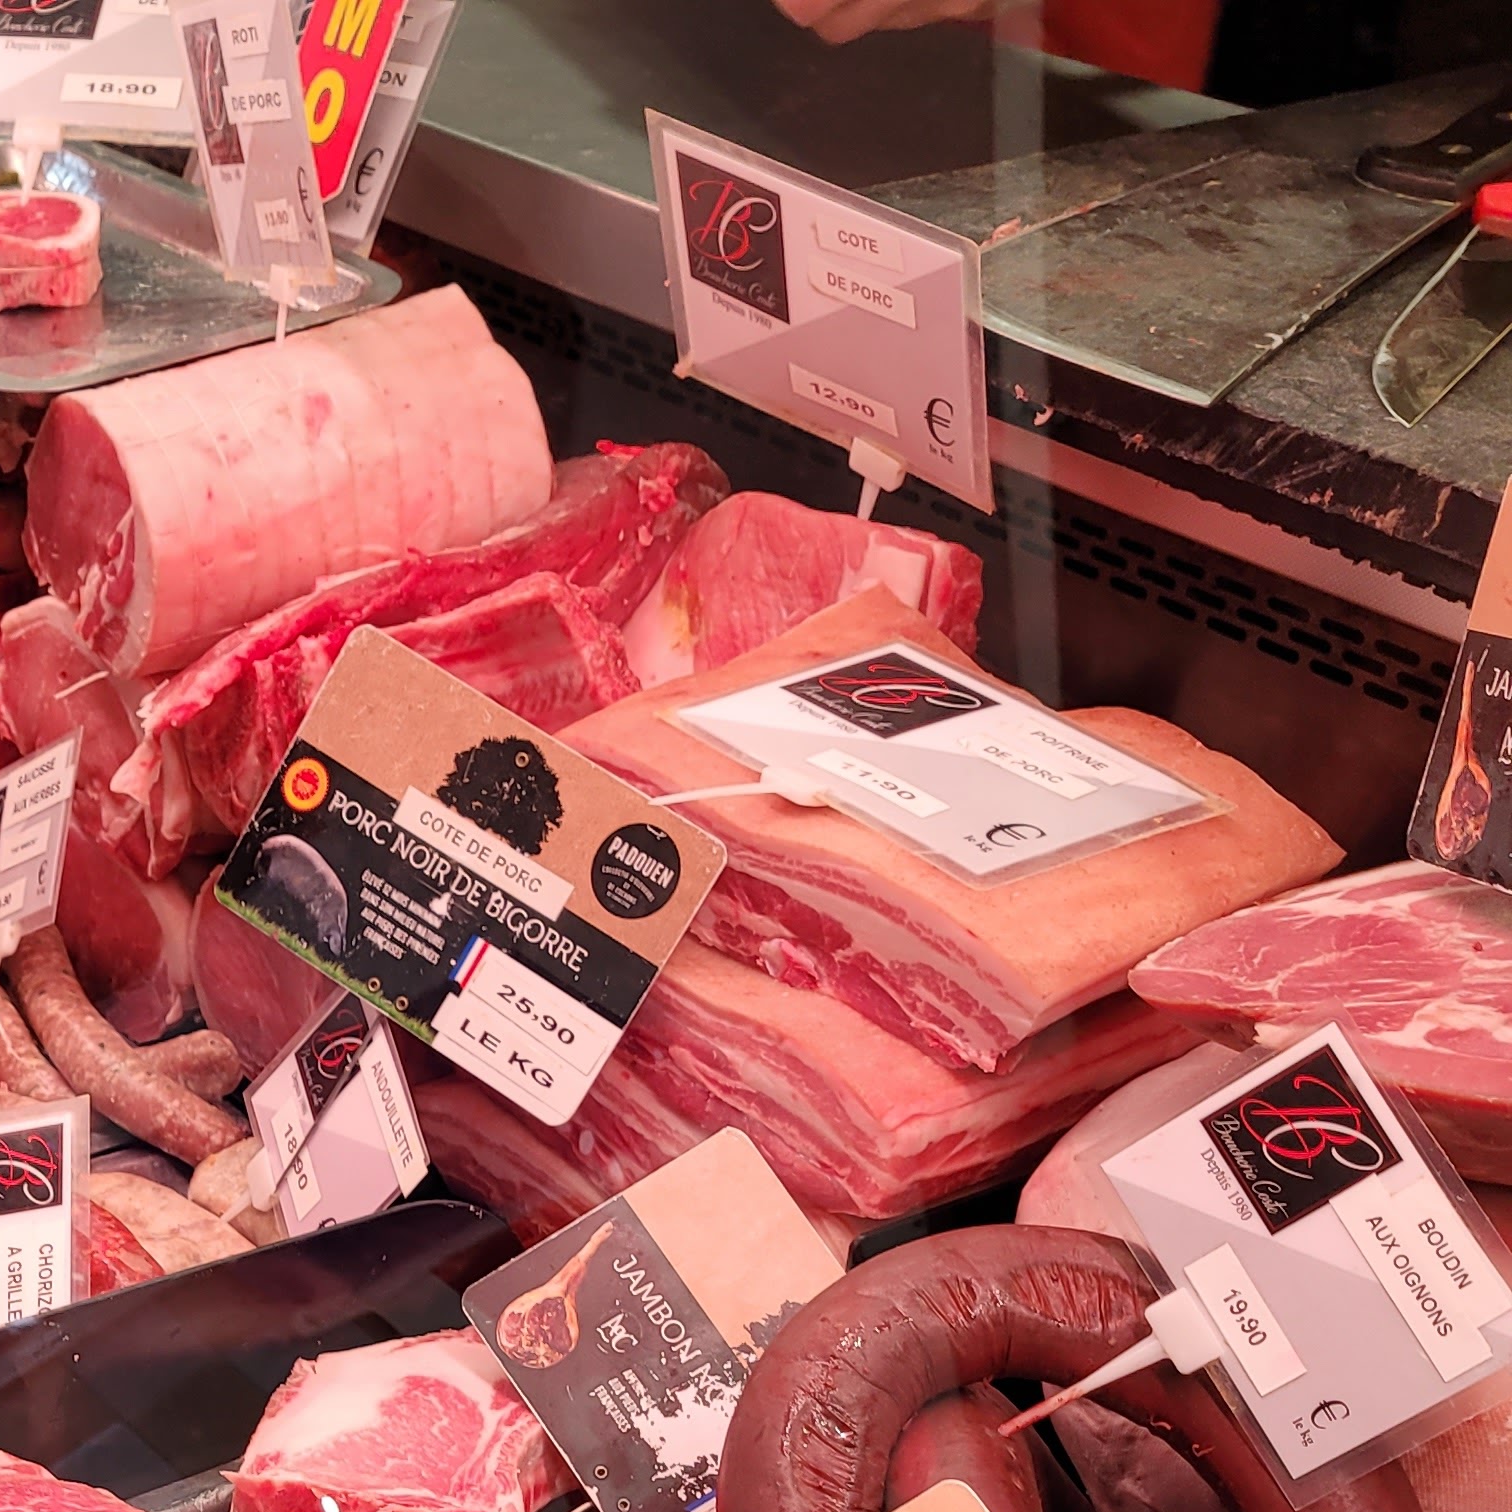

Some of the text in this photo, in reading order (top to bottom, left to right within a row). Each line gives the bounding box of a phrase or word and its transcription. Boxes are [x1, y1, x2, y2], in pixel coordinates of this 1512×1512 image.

[231, 25, 259, 46] ROTI
[231, 91, 283, 113] DE PORC
[837, 228, 880, 255] COTE
[826, 270, 895, 310] DE PORC
[982, 743, 1012, 763] DE
[1029, 729, 1109, 772] POITRINE
[328, 789, 393, 845] PORC
[389, 833, 453, 887] NOIR
[450, 868, 488, 908] DE
[484, 889, 589, 973] BIGORRE
[419, 810, 543, 894] COTE DE PORC
[607, 835, 676, 889] PADOUEN
[496, 983, 576, 1046] 25,90
[459, 1017, 555, 1090] LE KG
[370, 1060, 415, 1169] ANDOUILLETTE
[1200, 1147, 1254, 1221] Depuis 1980
[7, 1245, 23, 1259] A
[1364, 1214, 1455, 1339] AUX OIGNONS
[1417, 1216, 1474, 1292] BOUDIN
[612, 1253, 702, 1364] JAMBON
[1222, 1287, 1268, 1347] 19,90
